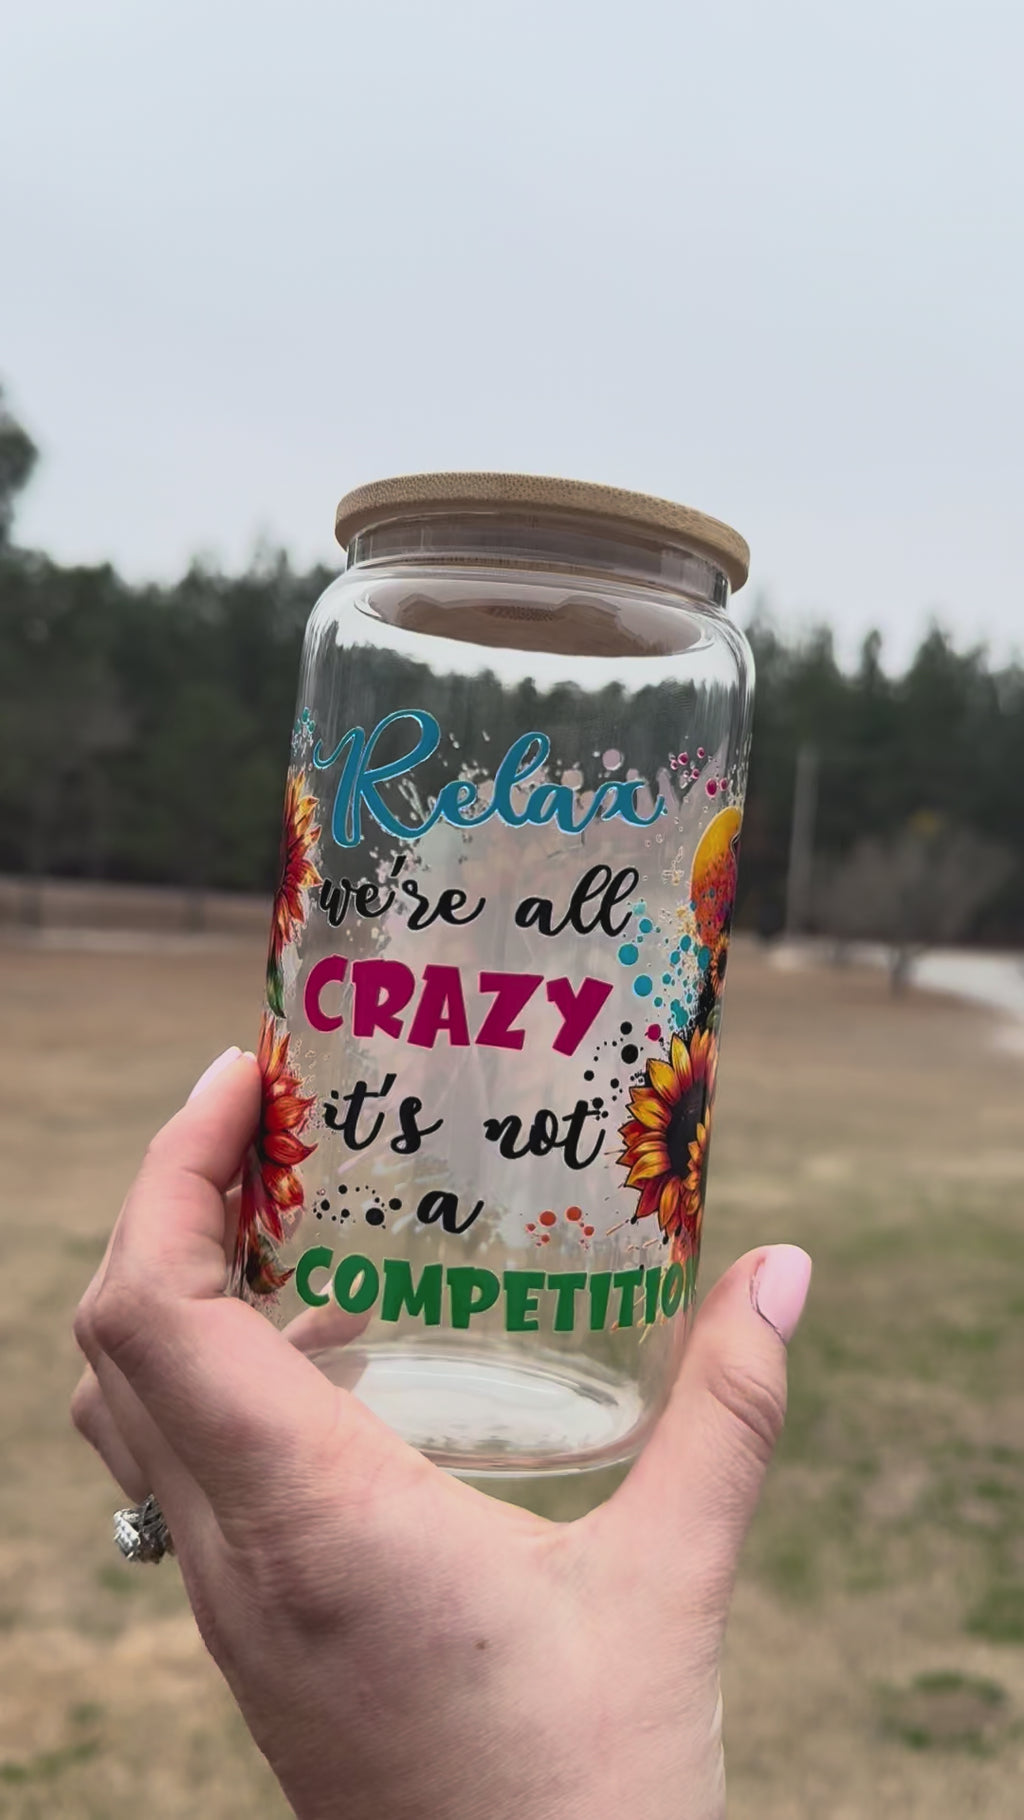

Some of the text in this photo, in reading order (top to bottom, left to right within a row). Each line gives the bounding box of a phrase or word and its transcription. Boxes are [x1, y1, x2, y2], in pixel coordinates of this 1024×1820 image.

[313, 708, 665, 848] Relax
[320, 855, 640, 937] we're all
[304, 954, 613, 1057] CRAZY
[324, 1073, 606, 1170] it's not
[417, 1190, 485, 1234] a
